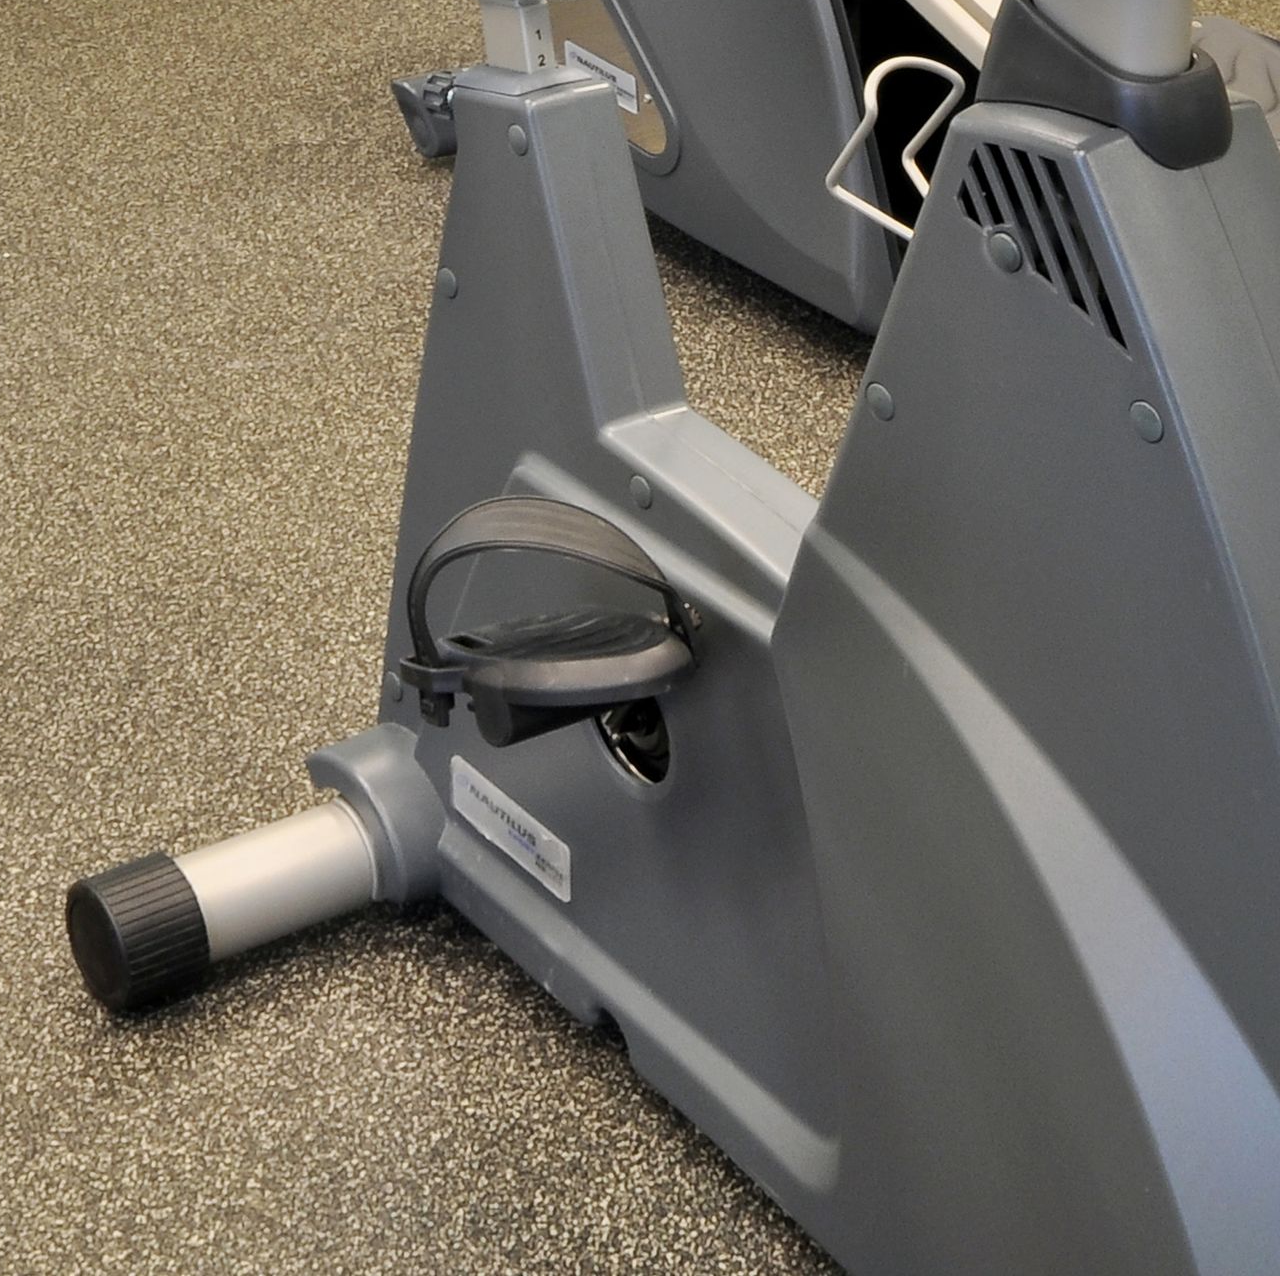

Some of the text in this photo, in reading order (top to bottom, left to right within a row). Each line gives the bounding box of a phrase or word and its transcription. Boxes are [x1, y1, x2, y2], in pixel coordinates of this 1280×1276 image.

[535, 29, 542, 40] 1
[538, 54, 546, 67] 2
[576, 55, 617, 83] NAUTILUS
[469, 784, 537, 847] NAUTILUS
